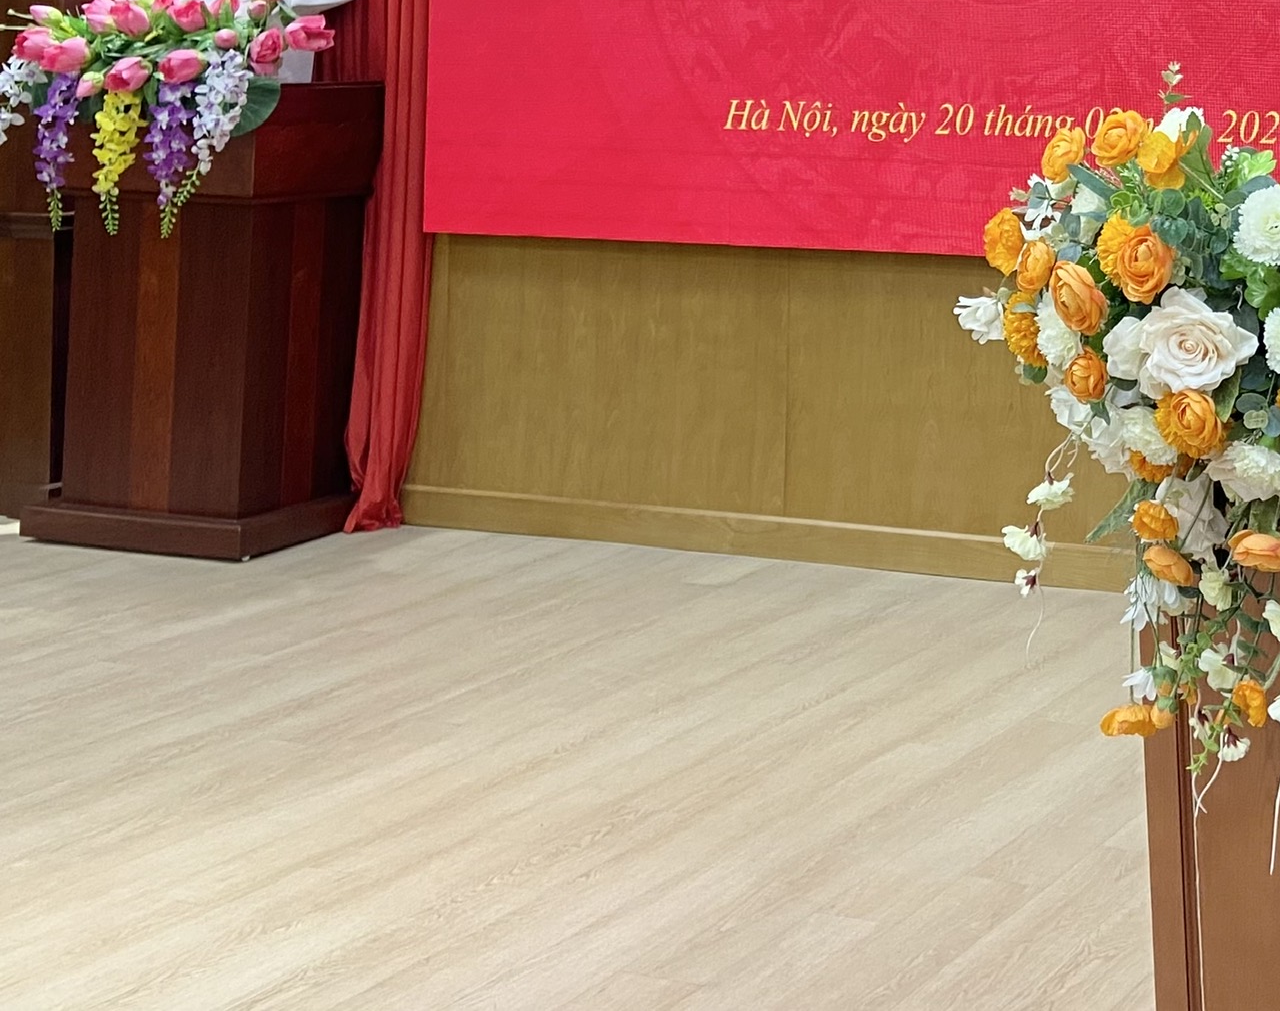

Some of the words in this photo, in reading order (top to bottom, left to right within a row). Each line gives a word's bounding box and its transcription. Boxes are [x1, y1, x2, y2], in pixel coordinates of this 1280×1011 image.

[724, 99, 770, 130] Hà
[777, 100, 838, 138] Nội,
[851, 110, 926, 143] ngày
[934, 103, 975, 135] 20
[1085, 107, 1123, 139] 0
